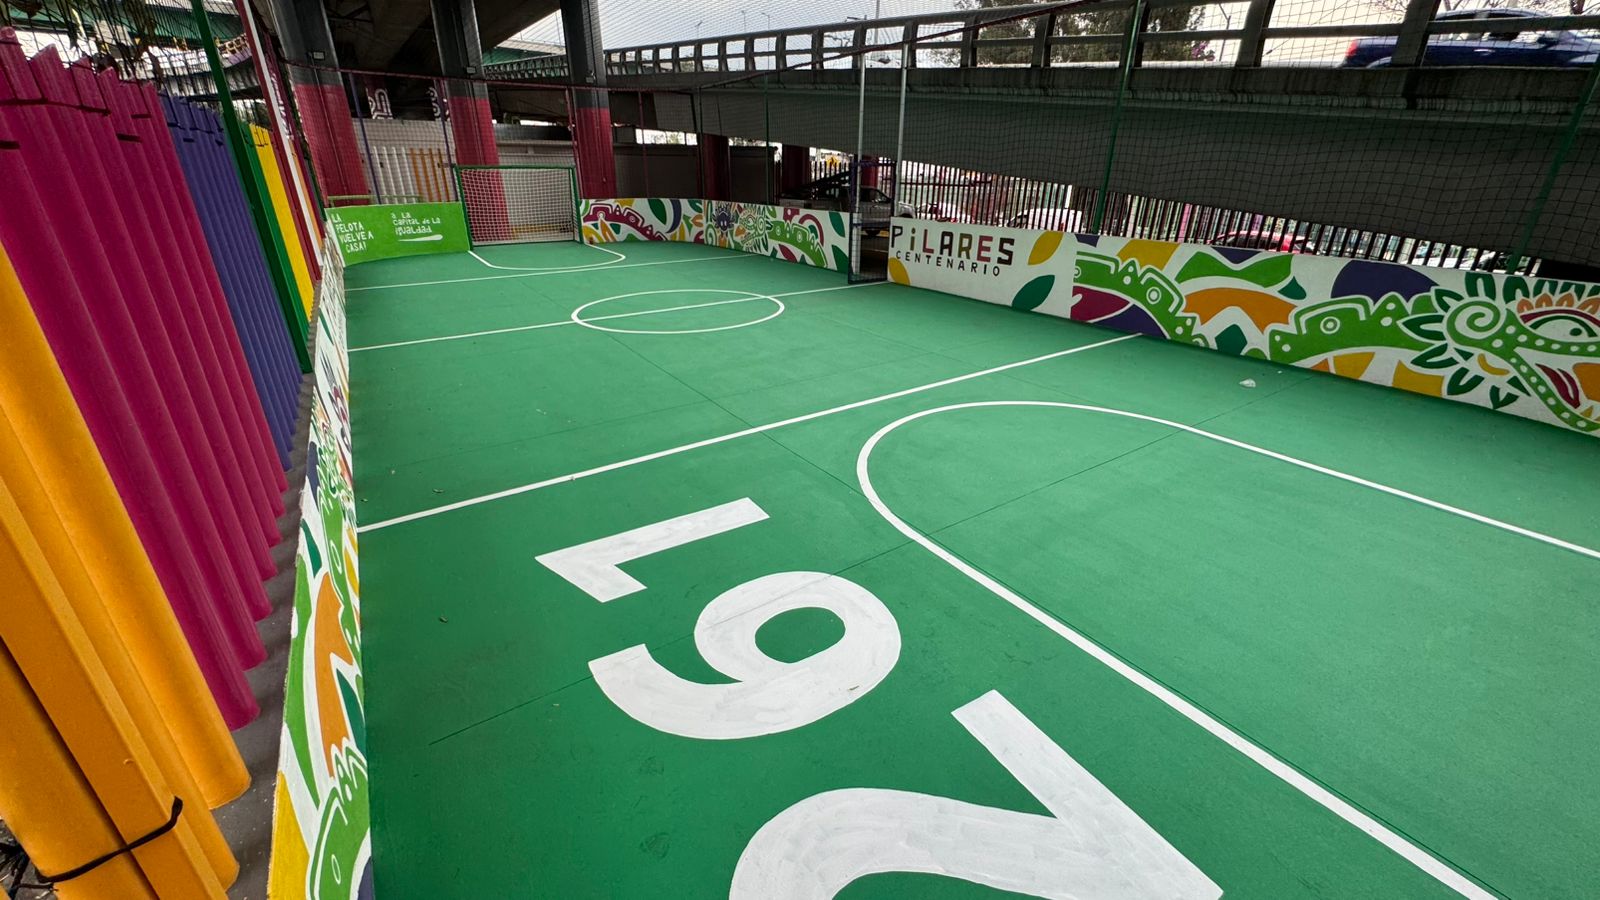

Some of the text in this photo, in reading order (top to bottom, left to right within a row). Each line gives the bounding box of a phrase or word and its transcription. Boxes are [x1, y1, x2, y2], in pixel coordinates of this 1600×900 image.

[331, 213, 342, 223] LA
[335, 221, 364, 233] PELOTA
[338, 230, 374, 244] VUELVE A
[345, 241, 367, 253] CASA!
[895, 251, 1000, 277] CENTENARIO
